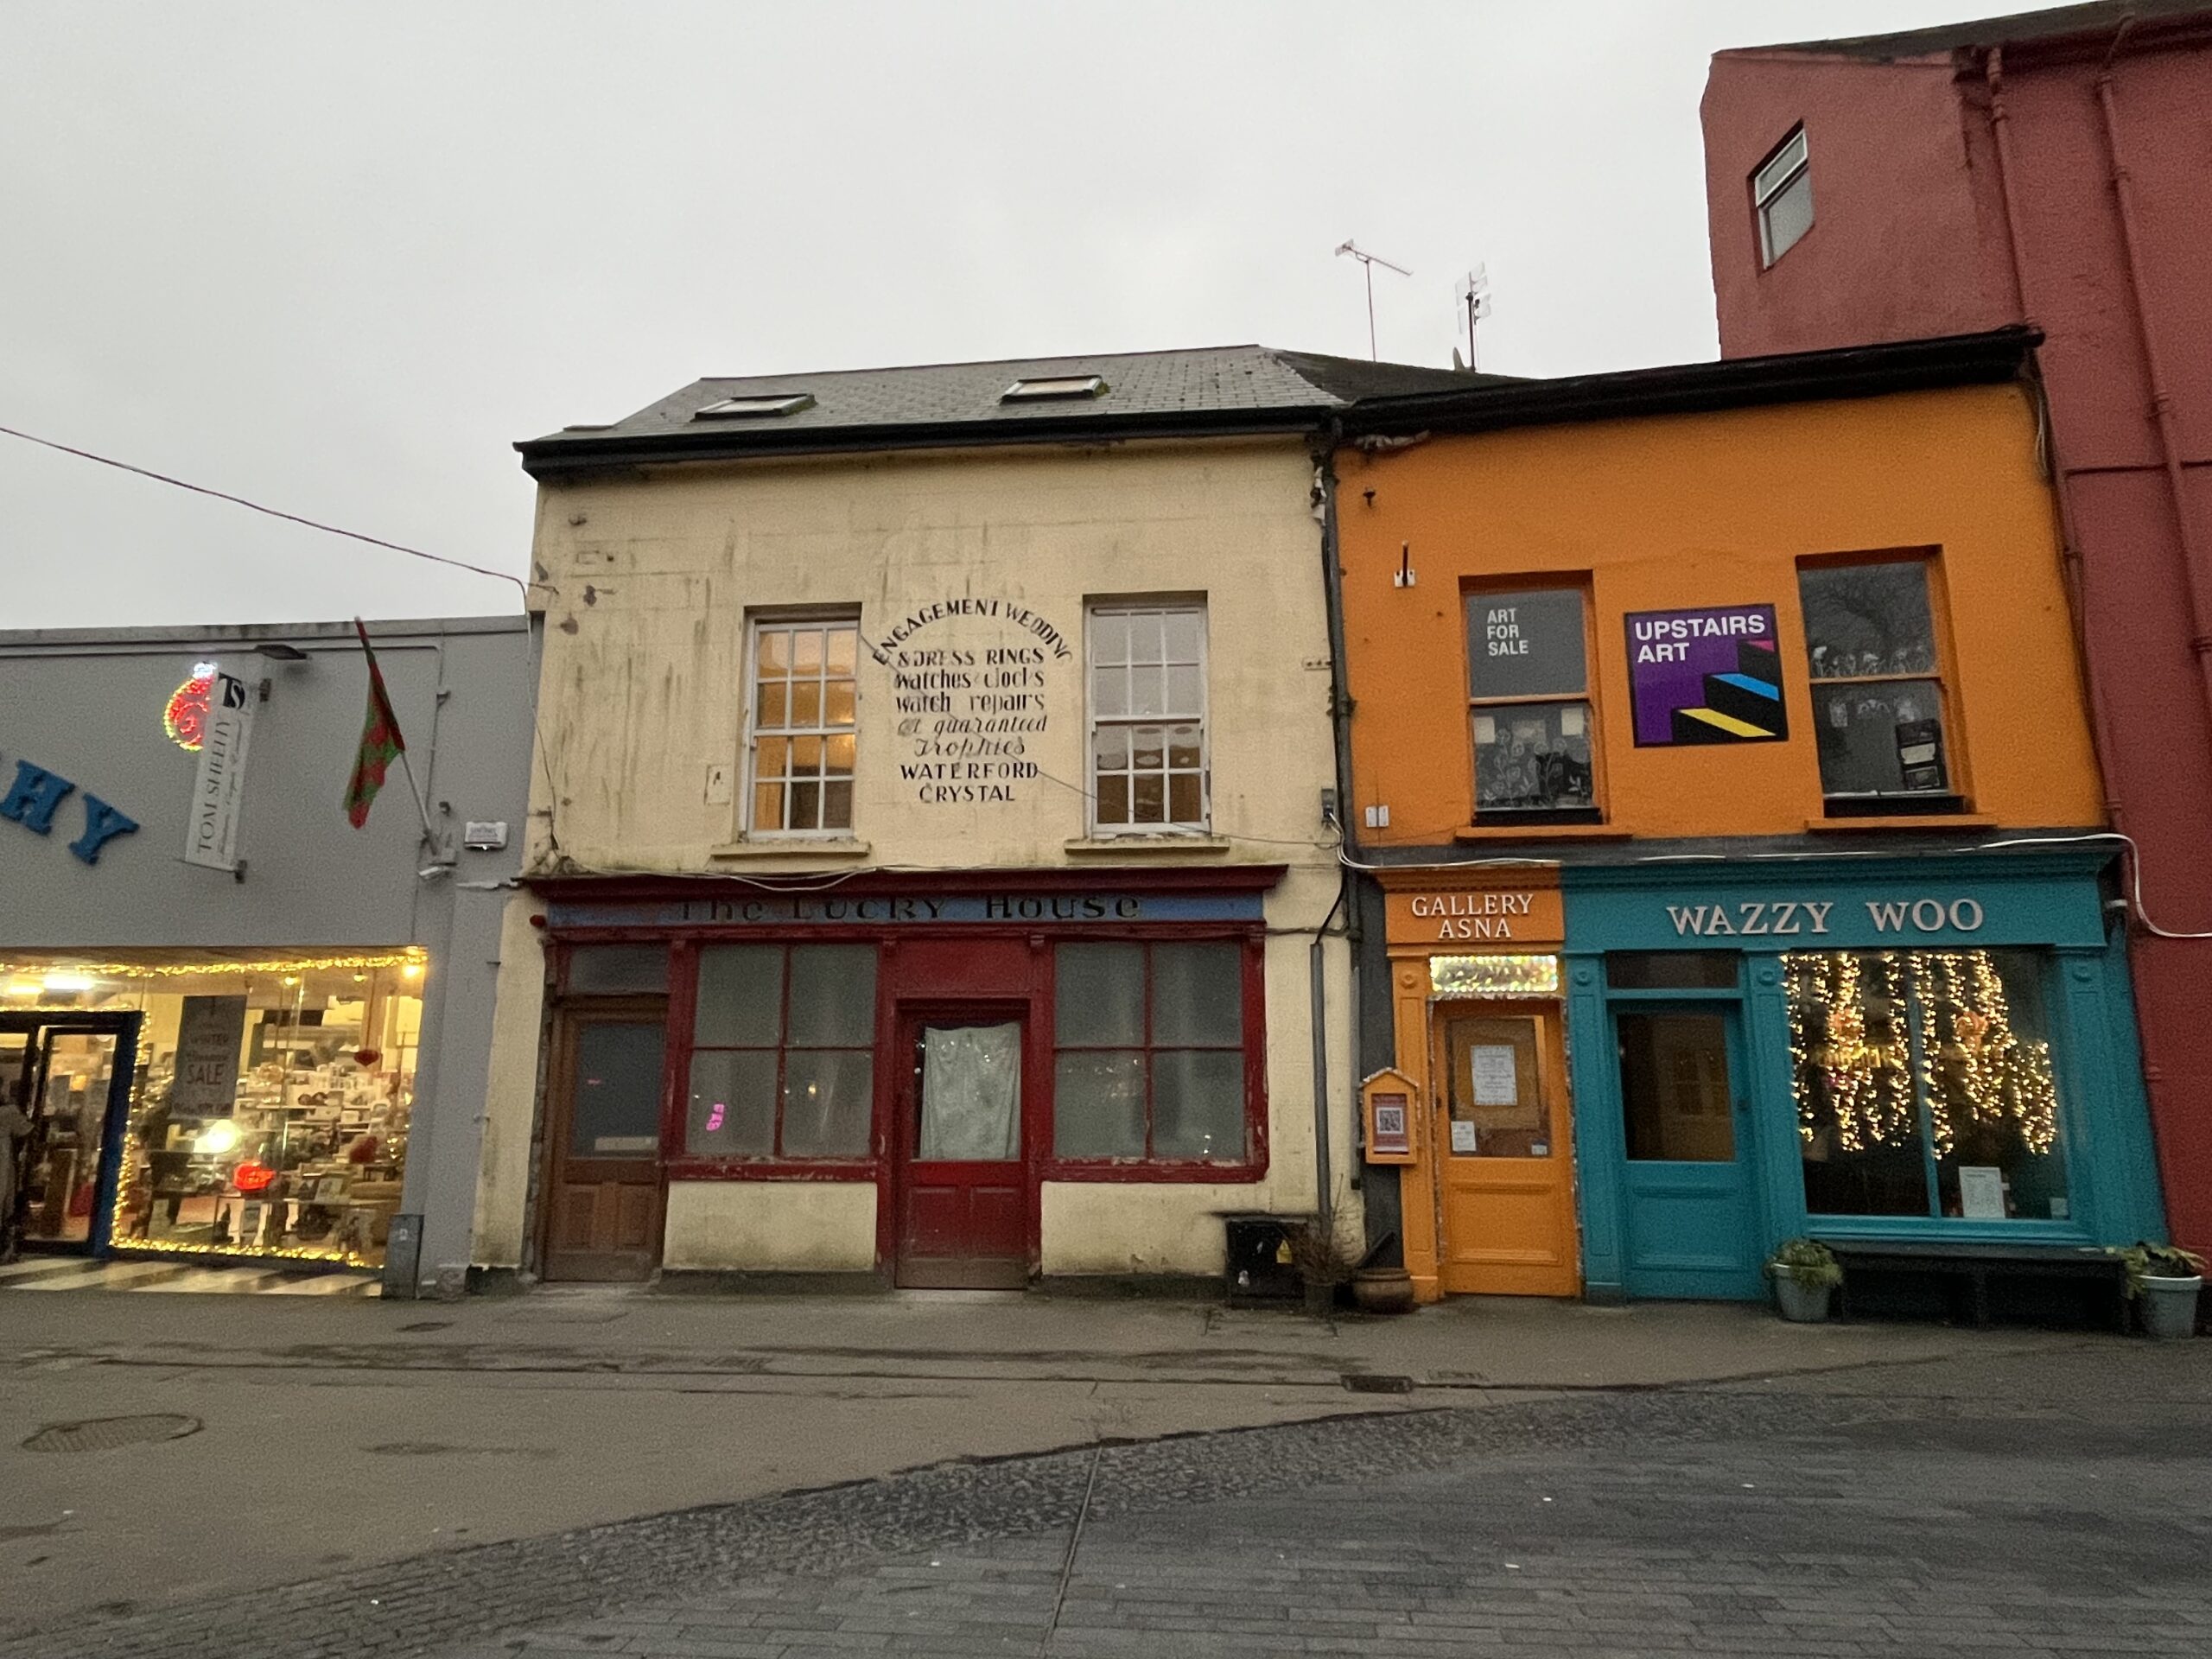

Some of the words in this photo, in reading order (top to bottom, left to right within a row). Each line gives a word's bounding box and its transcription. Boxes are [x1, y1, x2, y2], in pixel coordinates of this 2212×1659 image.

[1486, 608, 1516, 624] ART
[872, 599, 998, 665] ENGAGEMENT
[1486, 624, 1519, 640] FOR
[1635, 614, 1765, 641] UPSTAIRS
[986, 647, 1045, 664] RINGS
[1488, 639, 1529, 657] SALE
[1637, 642, 1690, 664] ART
[969, 694, 1045, 715] repairs
[934, 715, 1047, 739] guaranteed
[914, 735, 1025, 761] Trophies
[899, 761, 1039, 779] WATERFORD
[918, 783, 1015, 803] CRYSTAL
[0, 758, 140, 866] HY
[196, 801, 218, 855] TOM
[1411, 893, 1534, 918] GALLERY
[1666, 902, 1834, 935] WAZZY
[1866, 899, 1984, 931] WOO
[1438, 918, 1511, 939] ASNA
[186, 1063, 225, 1085] SALE
